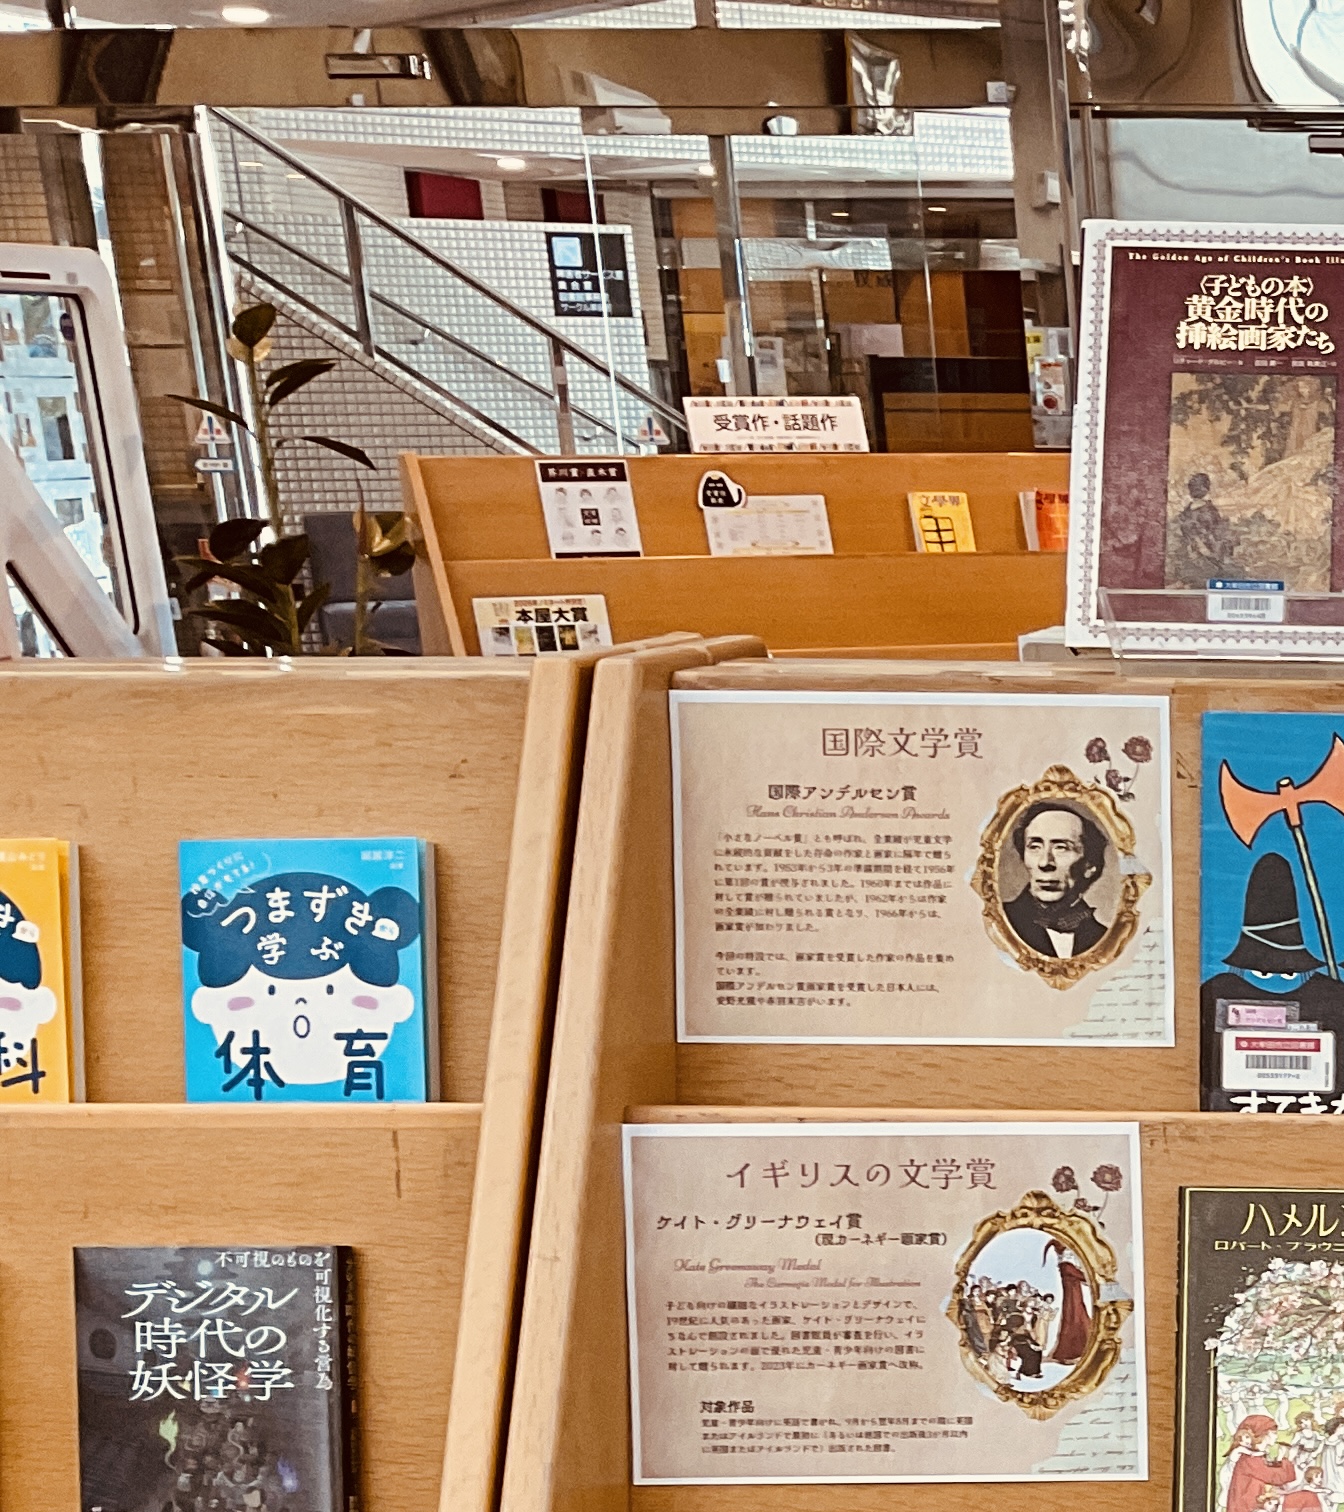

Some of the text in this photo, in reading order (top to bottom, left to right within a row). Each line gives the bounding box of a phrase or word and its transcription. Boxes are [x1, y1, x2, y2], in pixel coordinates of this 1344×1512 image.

[1128, 252, 1148, 261] The
[1193, 254, 1213, 263] Age
[1295, 255, 1321, 264] Book
[1183, 294, 1329, 324] 黄金時代の
[1175, 320, 1336, 355] 挿絵画家たち
[516, 607, 589, 623] 本屋大賞
[820, 726, 984, 759] 国際文学賞
[767, 783, 918, 802] 国際アンデルセン賞
[219, 883, 375, 937] つまずき
[256, 932, 345, 967] 学ぶ
[215, 1029, 390, 1101] 体育
[725, 1157, 997, 1191] イギリスの文学賞
[656, 1212, 863, 1230] ケイト・グリーナウェイ賞
[121, 1279, 299, 1319] デジタル
[134, 1318, 287, 1359] 時代の
[128, 1359, 295, 1401] 妖怪学
[699, 1400, 755, 1414] 対象作品
